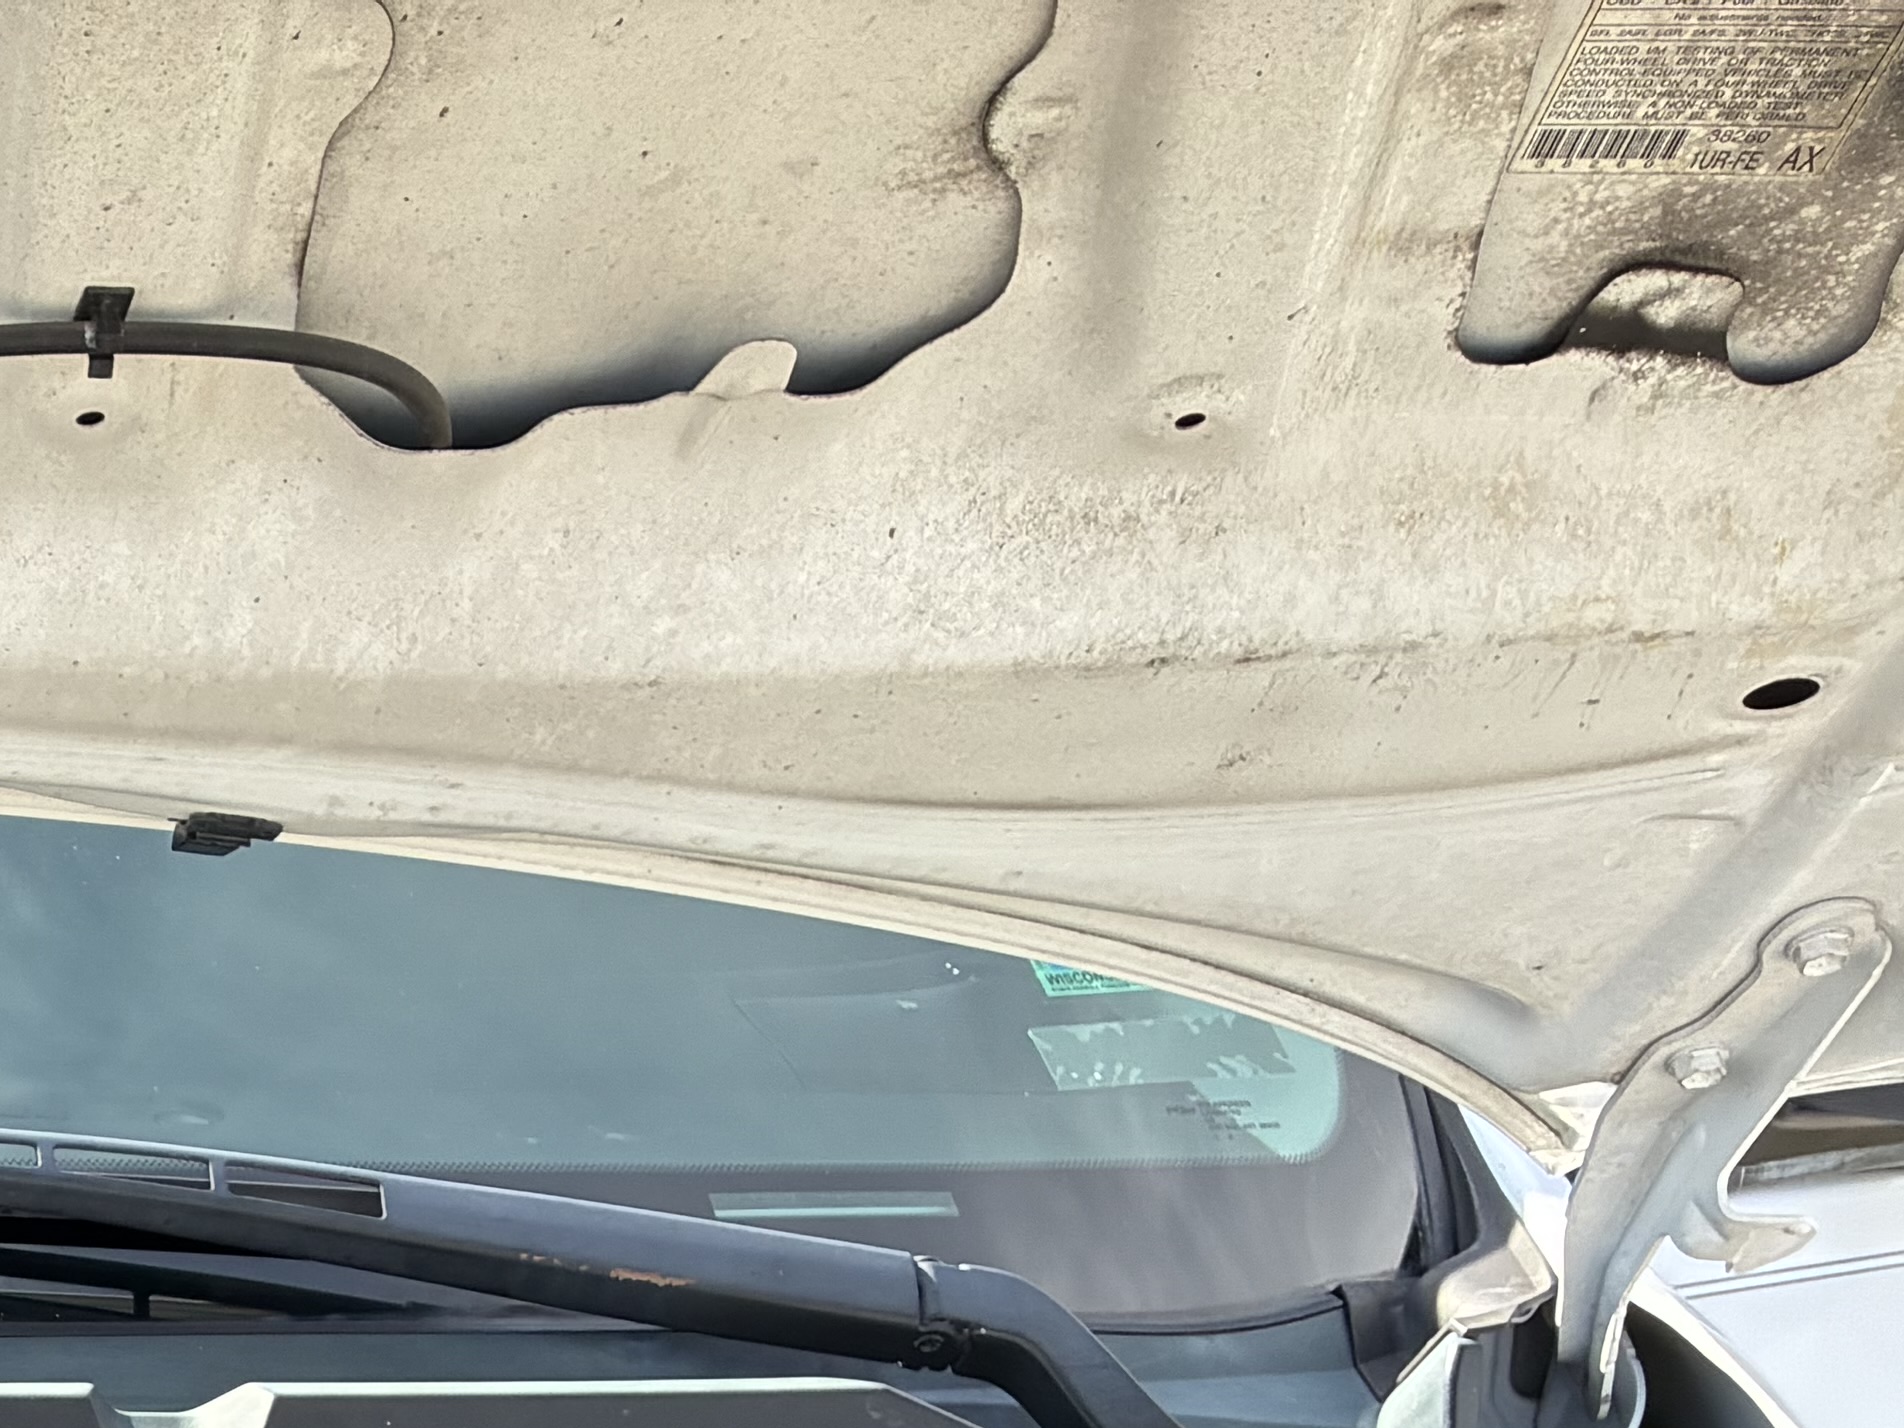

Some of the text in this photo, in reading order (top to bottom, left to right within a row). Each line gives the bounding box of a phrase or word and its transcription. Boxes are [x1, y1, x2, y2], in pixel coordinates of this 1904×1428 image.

[1580, 45, 1640, 56] LOADED
[1675, 45, 1736, 56] TESTING
[1769, 46, 1861, 58] PERMANENT
[1574, 56, 1669, 67] FOUR-WHEEL
[1675, 56, 1720, 67] DRIVE
[1758, 57, 1832, 68] TRACTION
[1723, 67, 1794, 78] VEHICLES
[1800, 68, 1844, 79] MUST
[1562, 78, 1655, 89] CONDUCTED
[1659, 79, 1684, 89] ON
[1687, 79, 1699, 89] A
[1557, 89, 1608, 99] SPEED
[1646, 100, 1659, 110] A
[1663, 100, 1758, 111] NON-LOADED
[1546, 110, 1636, 121] PROCEDURE
[1640, 110, 1686, 121] MUST
[1706, 129, 1773, 144] 38260
[1688, 144, 1828, 174] 1UR-FE AX
